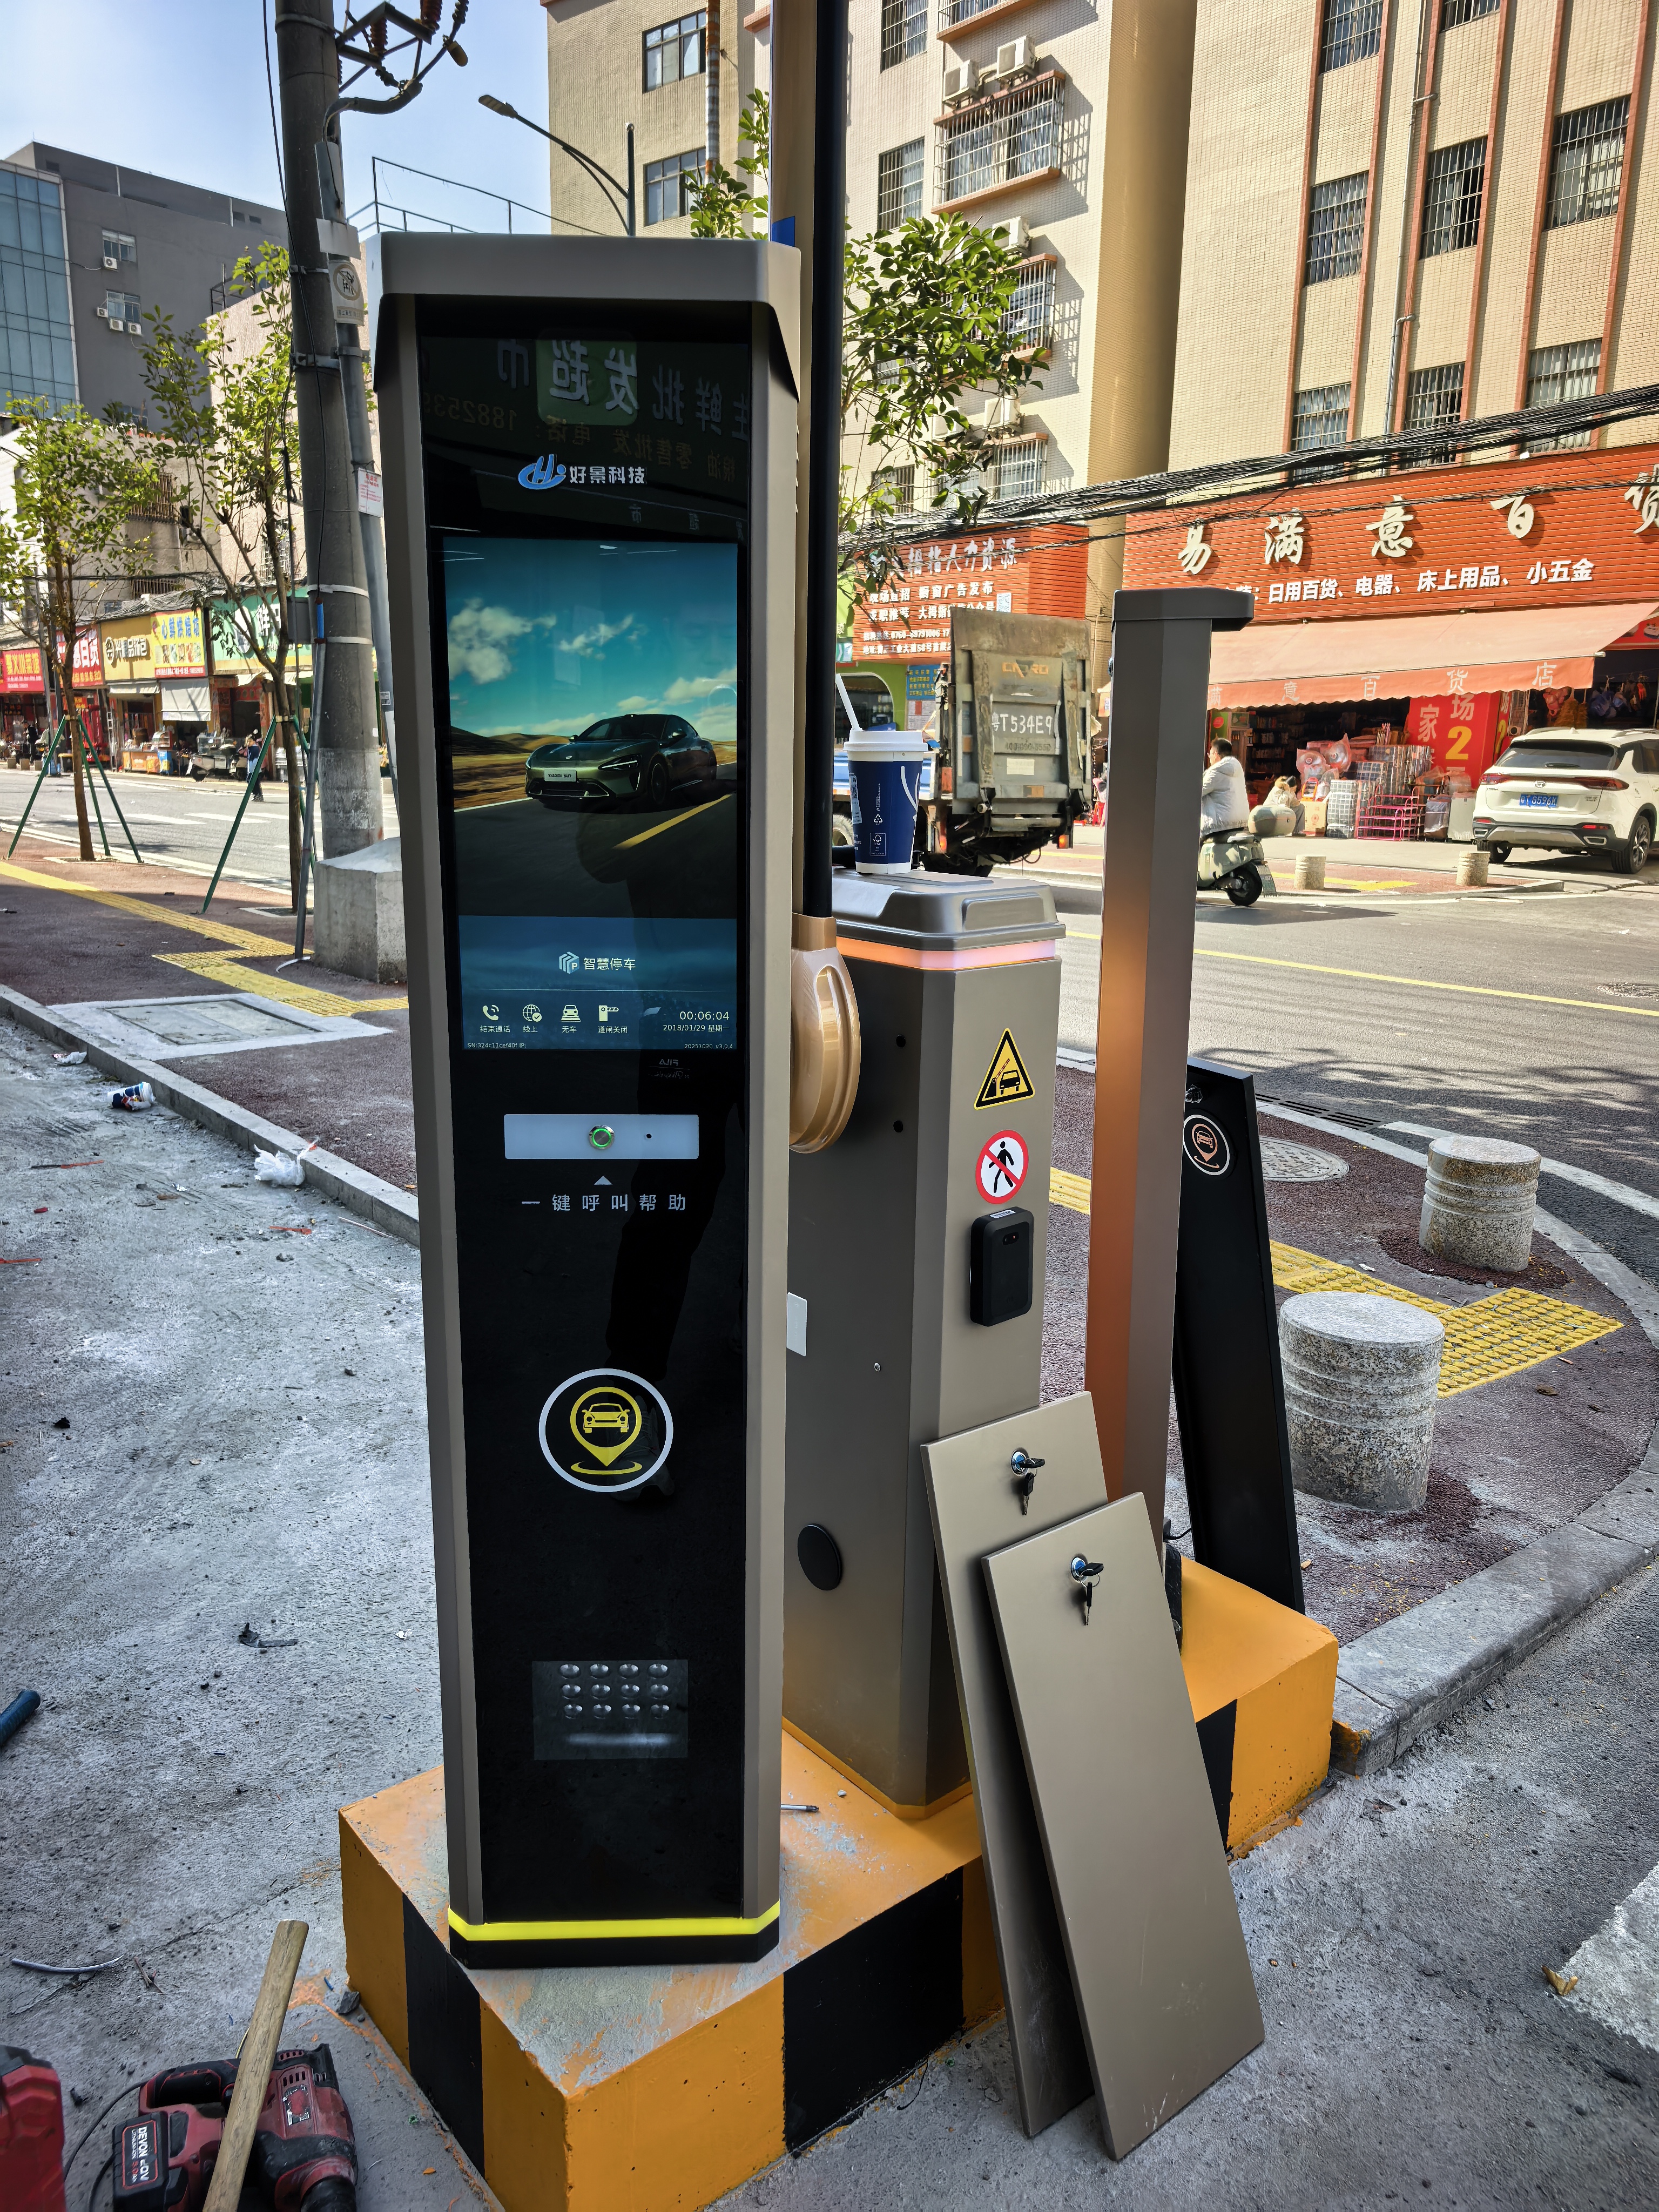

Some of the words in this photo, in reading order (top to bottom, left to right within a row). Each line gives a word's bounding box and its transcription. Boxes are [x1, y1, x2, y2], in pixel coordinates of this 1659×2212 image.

[570, 466, 646, 484] 好景科技
[1418, 704, 1440, 742] 家
[583, 957, 636, 971] 智慧停车
[679, 1011, 730, 1020] 00:06:04
[480, 1025, 510, 1033] 结束通话
[598, 1026, 628, 1034] 道闸关闭
[521, 1194, 686, 1212] 一键呼叫帮助
[137, 2126, 149, 2158] DEVON
